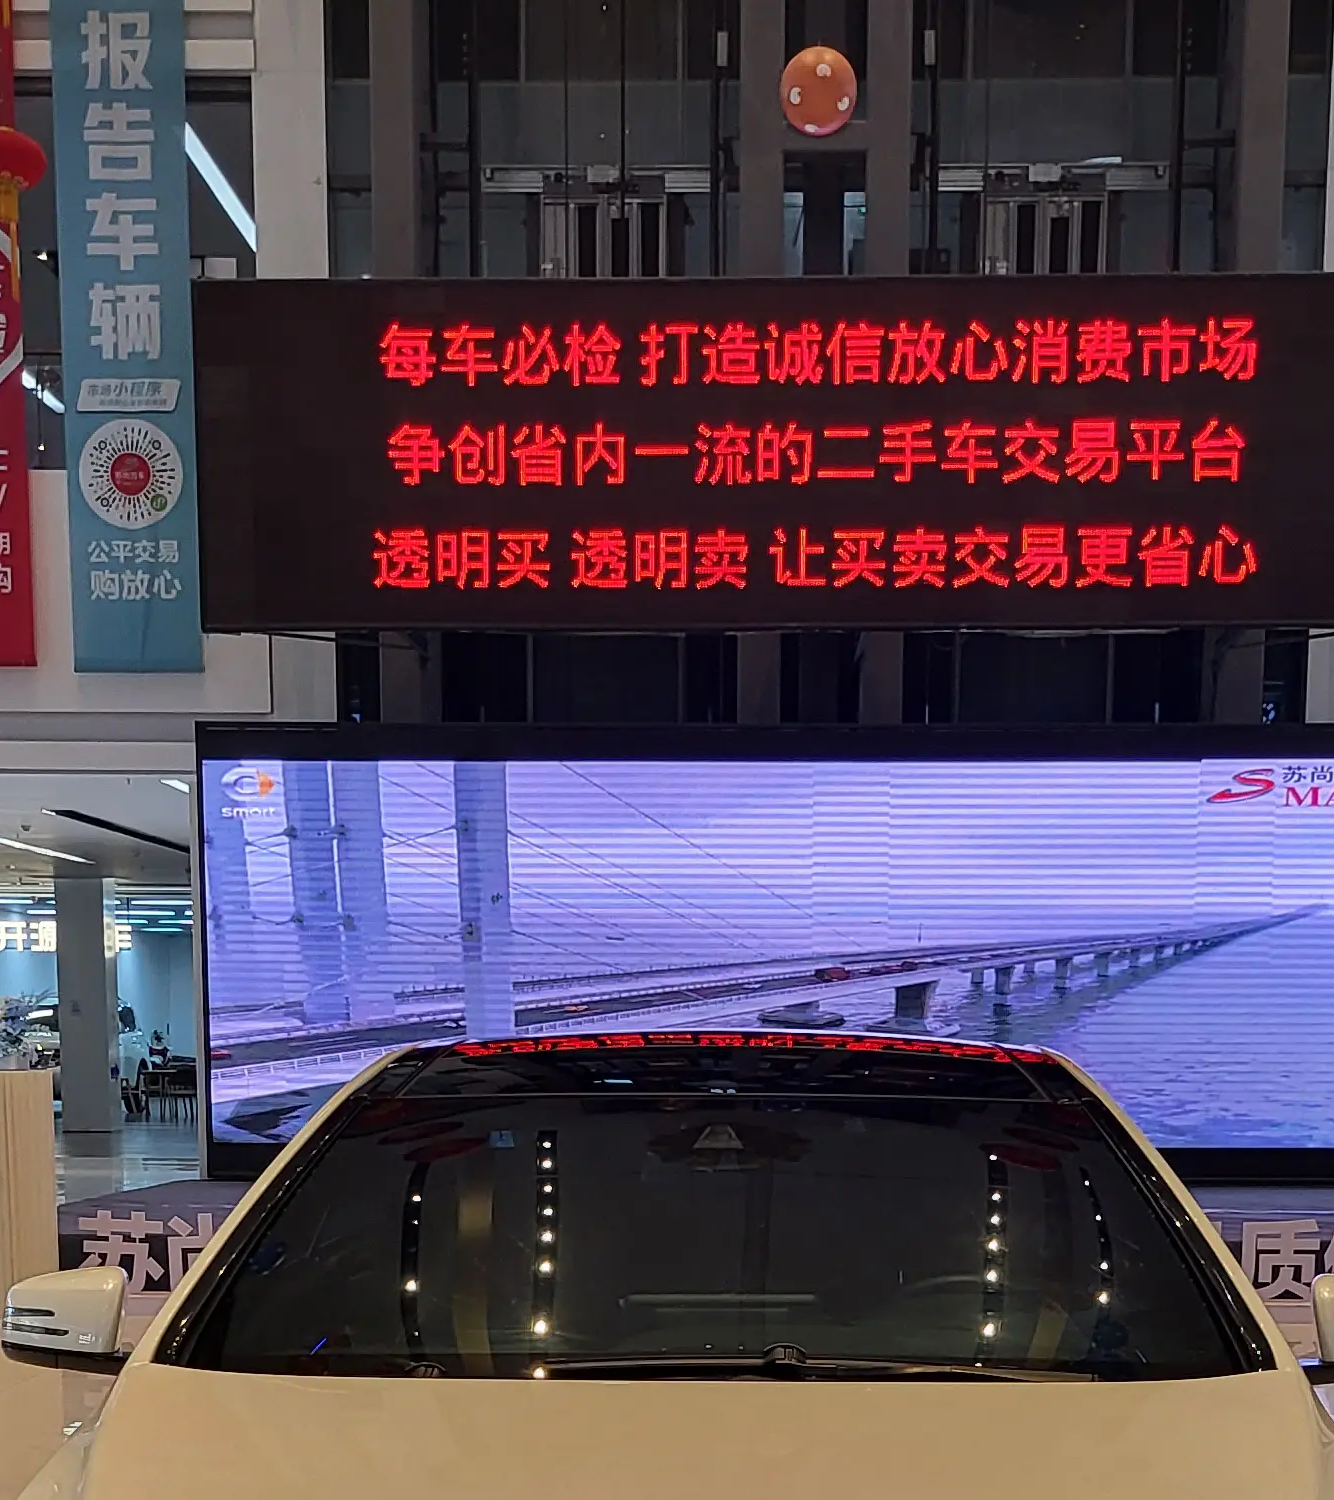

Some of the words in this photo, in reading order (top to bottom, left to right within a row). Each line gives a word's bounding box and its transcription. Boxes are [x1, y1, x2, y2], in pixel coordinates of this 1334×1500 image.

[80, 10, 161, 360] 报告车辆
[379, 321, 622, 387] 每车必检
[639, 316, 1258, 386] 打造诚信放心消费市场
[387, 417, 1246, 486] 争创省内一流的二手车交易平台
[87, 540, 179, 564] 公平交易
[90, 569, 182, 601] 购放心
[372, 527, 551, 590] 透明买
[570, 527, 749, 590] 透明卖
[768, 525, 1257, 588] 让买卖交易更省心
